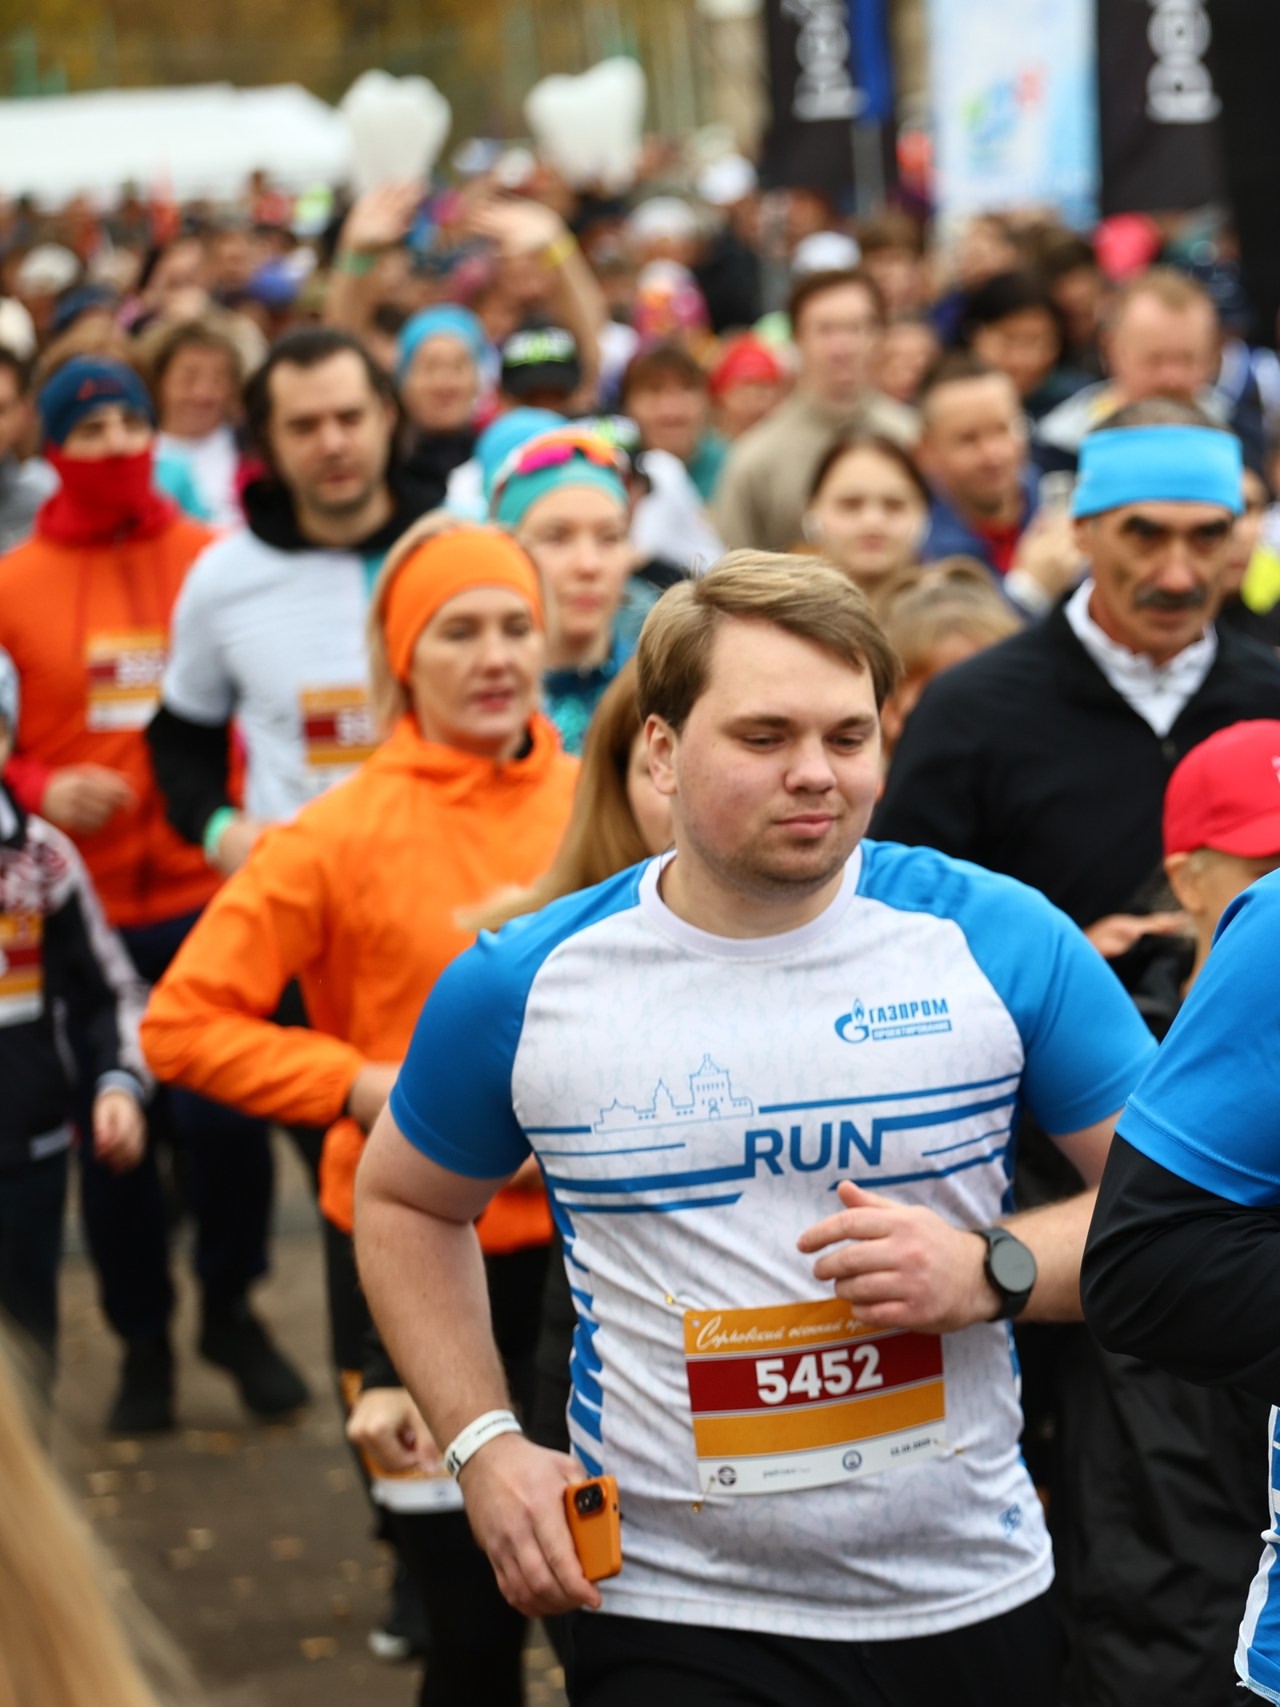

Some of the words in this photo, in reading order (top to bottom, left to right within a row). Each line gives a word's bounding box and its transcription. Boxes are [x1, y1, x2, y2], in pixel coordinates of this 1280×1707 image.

[869, 998, 948, 1024] ГАЗПРОМ
[745, 1117, 882, 1178] RUN
[755, 1343, 884, 1405] 5452
